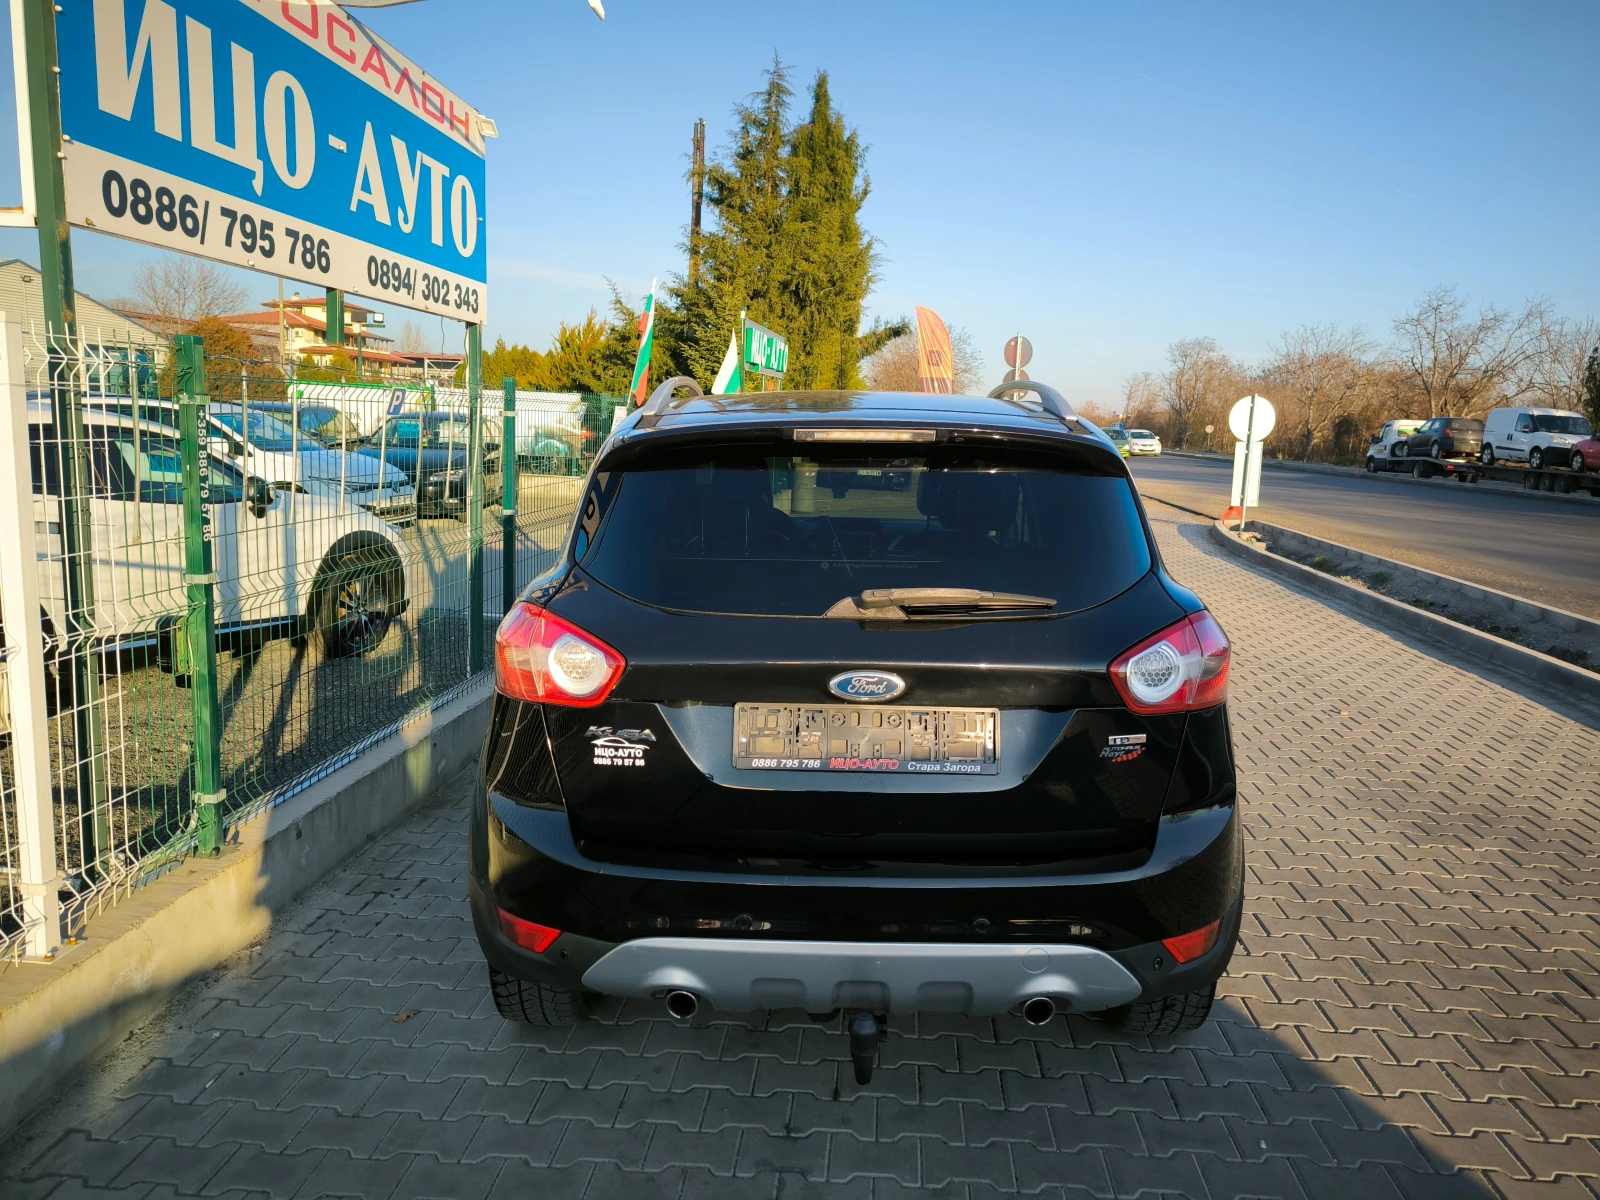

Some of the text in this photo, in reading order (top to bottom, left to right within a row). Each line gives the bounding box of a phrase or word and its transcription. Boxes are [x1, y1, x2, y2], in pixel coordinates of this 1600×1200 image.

[257, 0, 470, 141] ОСАЛОН
[93, 0, 478, 258] ИЦО-АУТО
[102, 169, 331, 273] 0886/ 795 786
[367, 255, 479, 314] 0894/ 302 343
[390, 391, 402, 413] P
[197, 409, 211, 541] +359 886 79 57 86
[847, 676, 887, 695] Ford
[593, 757, 645, 766] 0886 79 57 86
[594, 747, 643, 758] ИЦО-АУТО
[751, 758, 821, 768] 0886 795 786
[829, 758, 899, 771] ИЦО-АУТО
[907, 761, 981, 773] Стара Загора
